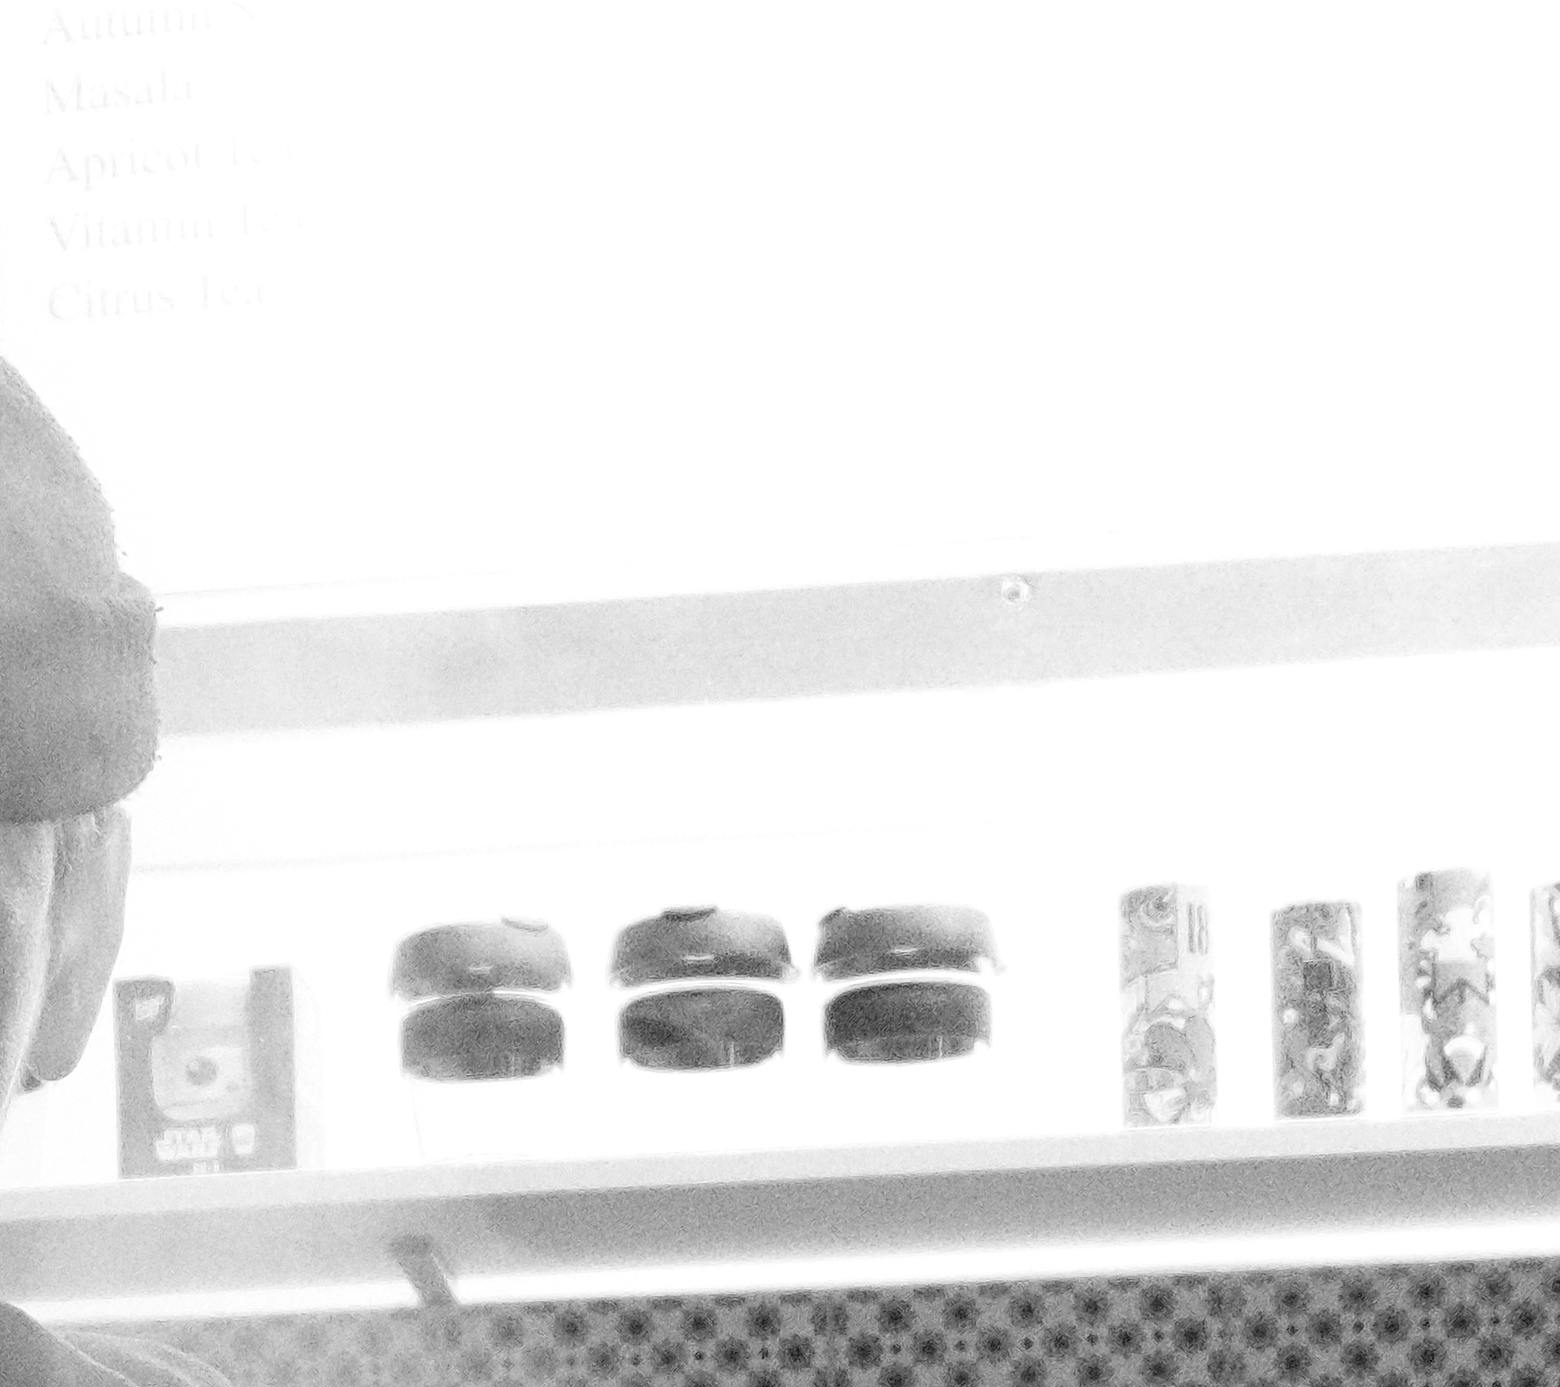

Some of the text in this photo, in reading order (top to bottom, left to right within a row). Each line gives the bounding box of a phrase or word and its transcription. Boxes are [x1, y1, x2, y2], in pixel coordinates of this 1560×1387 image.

[42, 66, 195, 117] Masala
[43, 136, 203, 194] Apricot
[46, 278, 178, 325] Citrus
